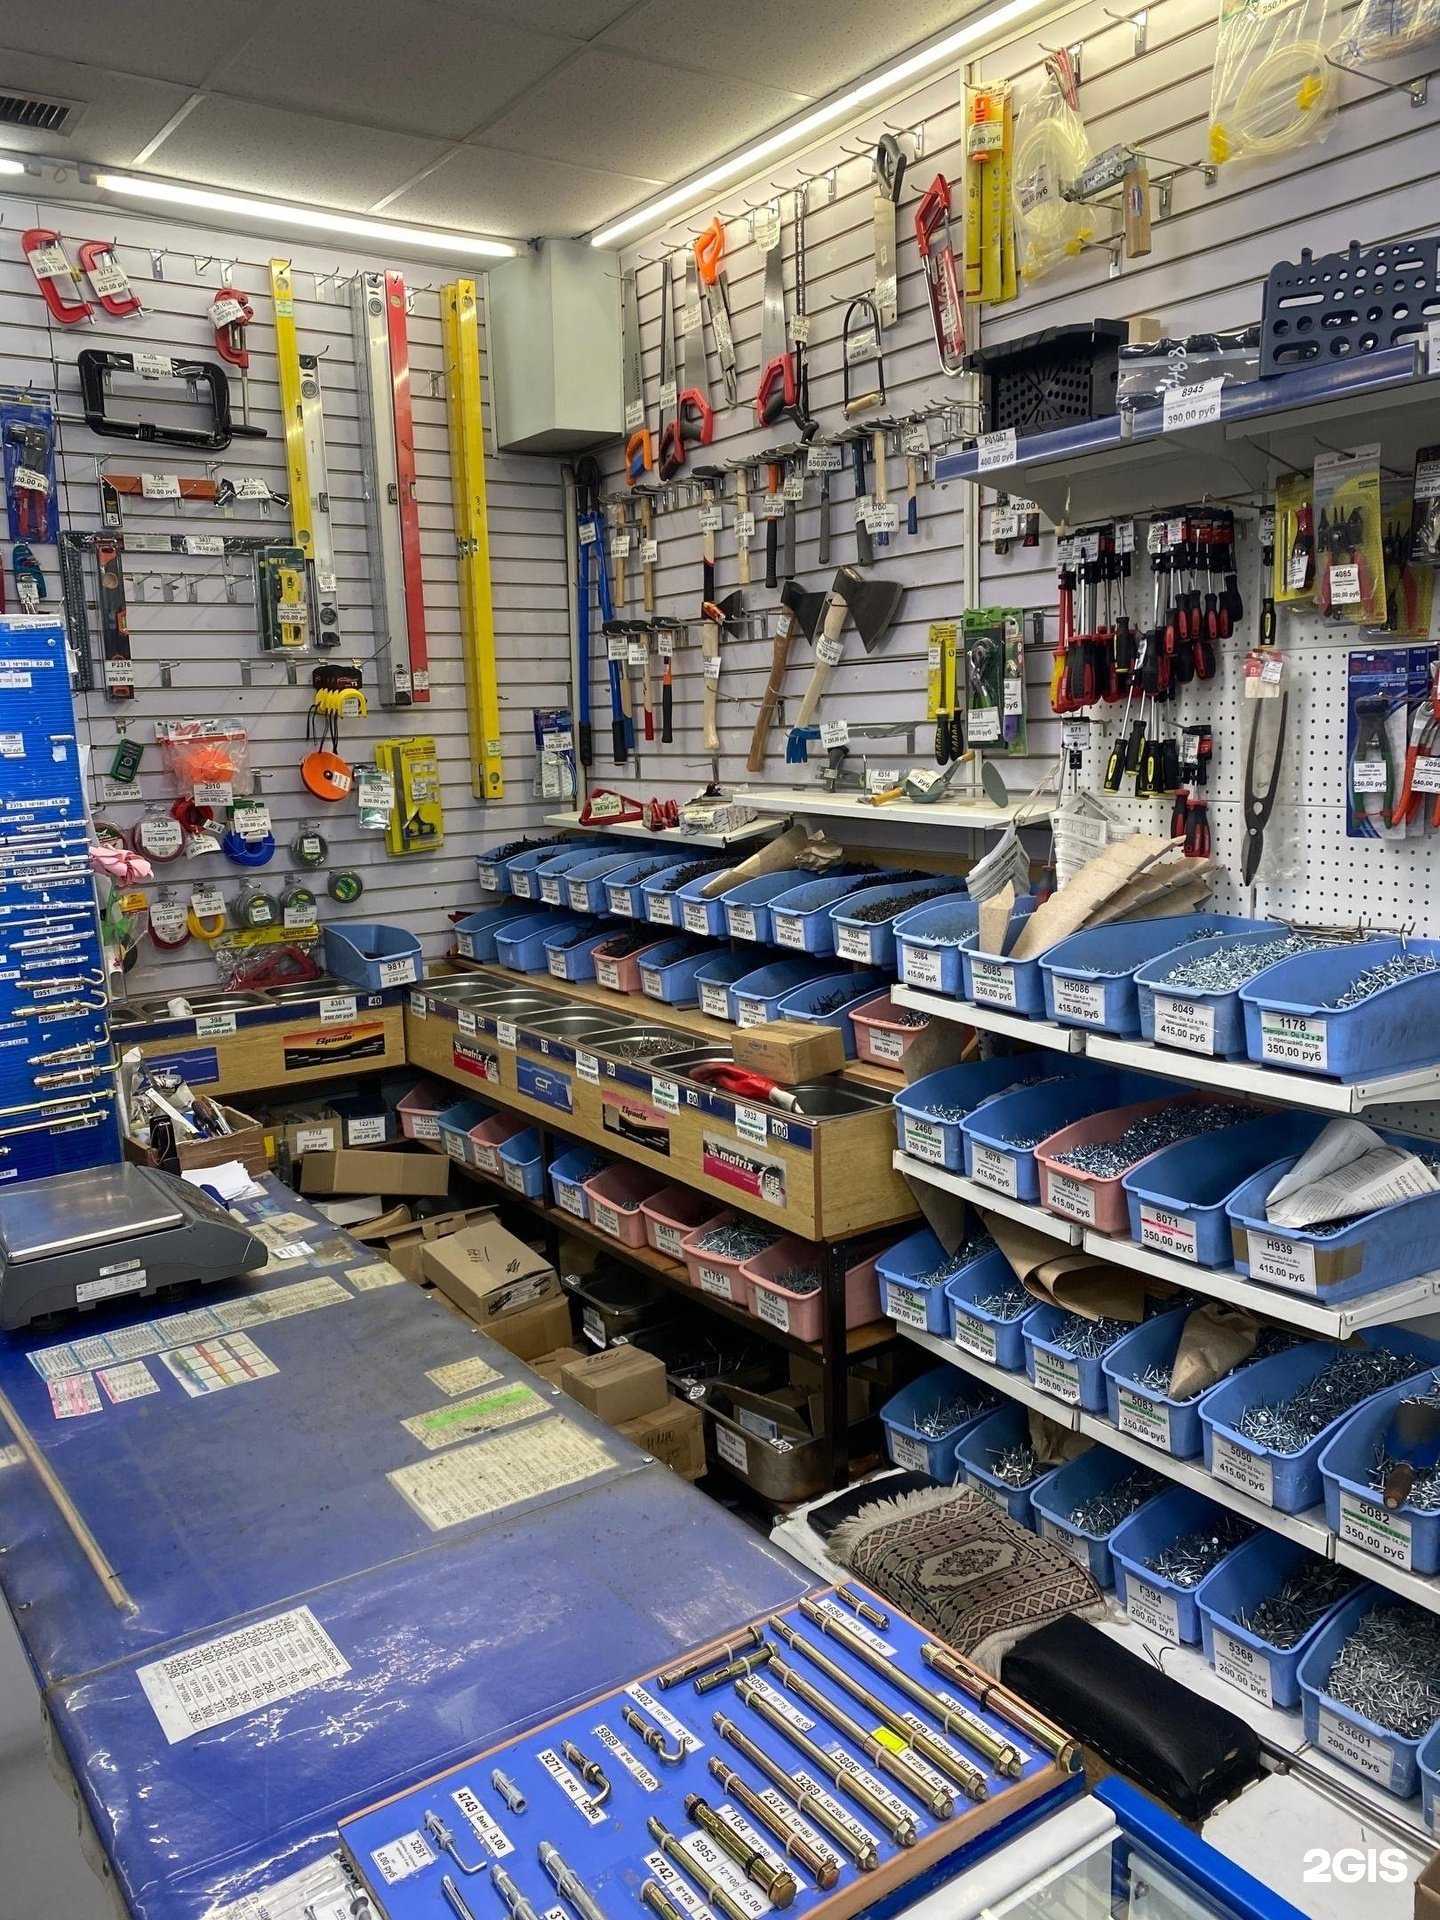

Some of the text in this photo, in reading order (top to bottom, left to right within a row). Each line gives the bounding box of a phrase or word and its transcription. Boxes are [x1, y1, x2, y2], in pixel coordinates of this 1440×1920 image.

[1181, 383, 1204, 397] 8945
[1168, 405, 1215, 425] 390,00 руб
[828, 459, 840, 467] руб
[1002, 451, 1014, 461] руб
[918, 778, 930, 788] руб
[387, 962, 406, 970] 9817
[925, 973, 937, 982] руб
[370, 997, 381, 1005] 40
[999, 991, 1012, 1001] руб
[1058, 1003, 1099, 1019] 415,00 руб
[1172, 1003, 1193, 1015] 8049
[1280, 1018, 1306, 1031] 1178
[1161, 1025, 1205, 1042] 415,00 руб
[462, 1046, 482, 1061] matrix
[1267, 1044, 1321, 1061] 350,00 руб
[689, 1093, 698, 1104] 90
[929, 1147, 942, 1158] руб
[719, 1151, 755, 1172] matrix
[998, 1176, 1010, 1187] руб
[1076, 1206, 1090, 1217] руб
[1156, 1213, 1178, 1227] 8071
[1144, 1229, 1173, 1246] 350,00
[1176, 1242, 1193, 1254] руб
[1259, 1264, 1305, 1282] 415,00 руб
[912, 1314, 924, 1324] руб
[981, 1346, 993, 1357] руб
[1046, 1355, 1064, 1370] 1179
[1063, 1388, 1077, 1398] руб
[1151, 1430, 1165, 1443] руб
[1230, 1445, 1252, 1463] 5050
[1220, 1463, 1246, 1482] 415,00
[1249, 1478, 1264, 1490] руб
[1359, 1504, 1390, 1525] 5082
[1345, 1526, 1380, 1549] 350,00
[1383, 1544, 1404, 1560] руб
[1160, 1623, 1175, 1636] руб
[1228, 1642, 1253, 1663] 5368
[262, 1680, 275, 1694] 250
[274, 1675, 287, 1689] 110
[747, 1676, 769, 1692] 3050
[1251, 1682, 1267, 1698] руб
[631, 1690, 653, 1707] 3402
[598, 1728, 619, 1746] 5969
[1337, 1722, 1371, 1748] 53601
[542, 1752, 563, 1771] 3271
[1328, 1736, 1379, 1773] 200,00 руб
[834, 1753, 860, 1773] 3806
[796, 1775, 821, 1795] 3269
[764, 1793, 789, 1814] 2374
[458, 1792, 506, 1850] 4743 3,00
[725, 1808, 748, 1831] 7184
[411, 1840, 425, 1858] 3281
[384, 1865, 397, 1878] руб
[650, 1857, 674, 1881] 4742
[692, 1839, 717, 1863] 5953
[739, 1890, 762, 1911] 35,00
